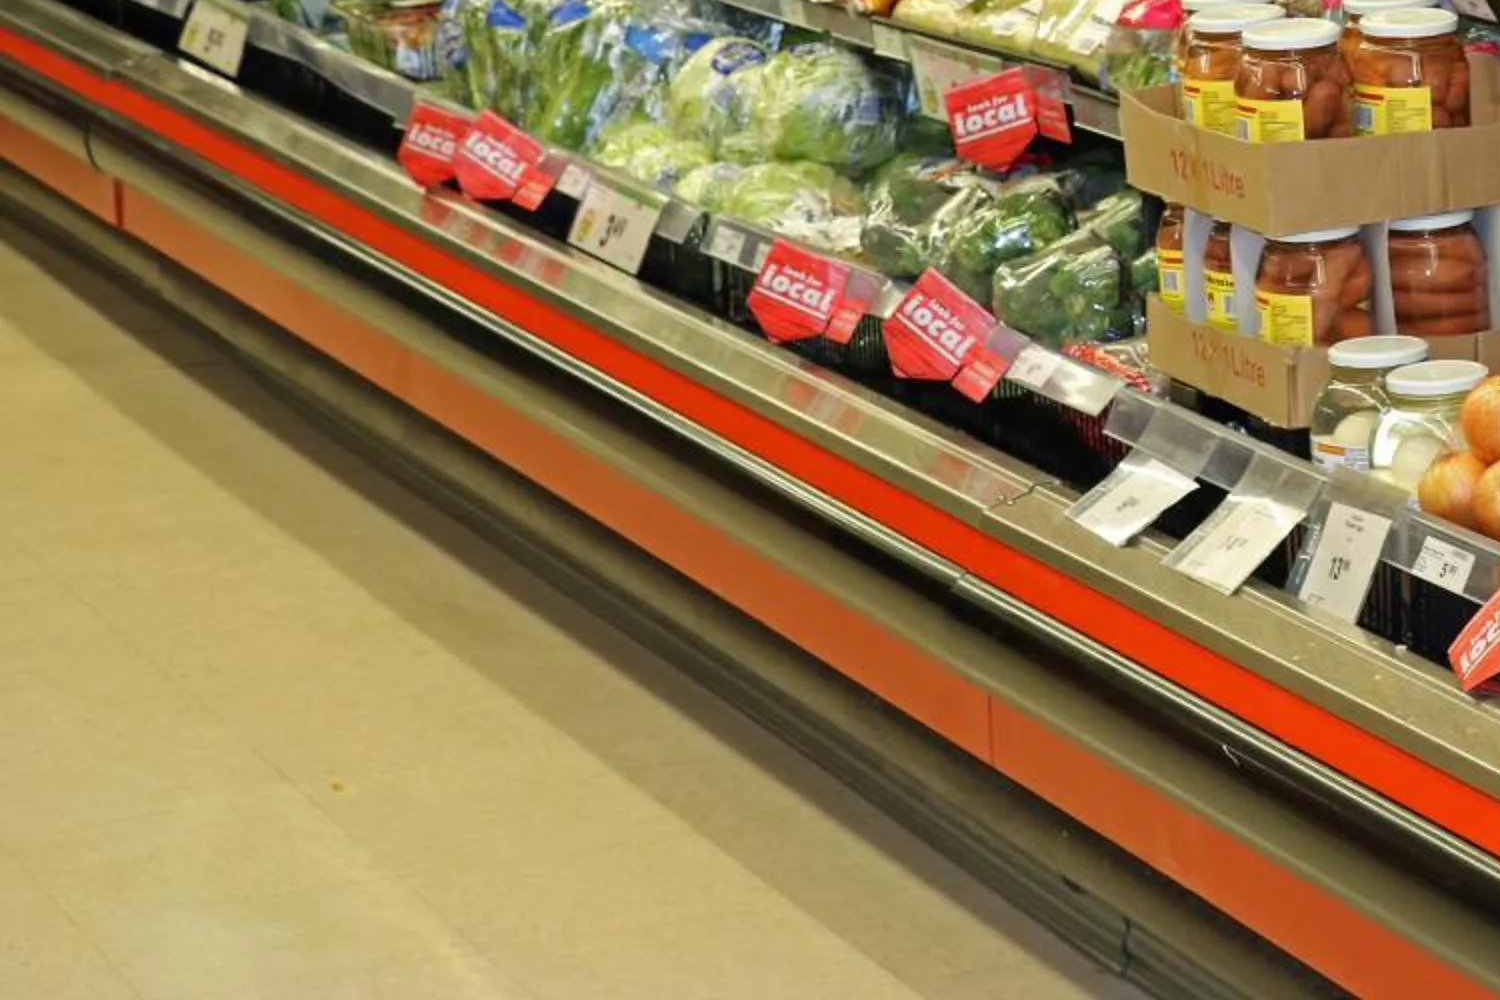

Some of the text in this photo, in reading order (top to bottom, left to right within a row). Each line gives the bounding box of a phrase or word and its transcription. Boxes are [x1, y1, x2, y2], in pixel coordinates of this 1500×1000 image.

[953, 93, 1028, 137] local
[408, 122, 456, 156] loca
[465, 130, 528, 181] local
[1210, 160, 1246, 199] Litre
[762, 264, 836, 312] local
[902, 294, 977, 359] local
[1231, 346, 1266, 389] Litre
